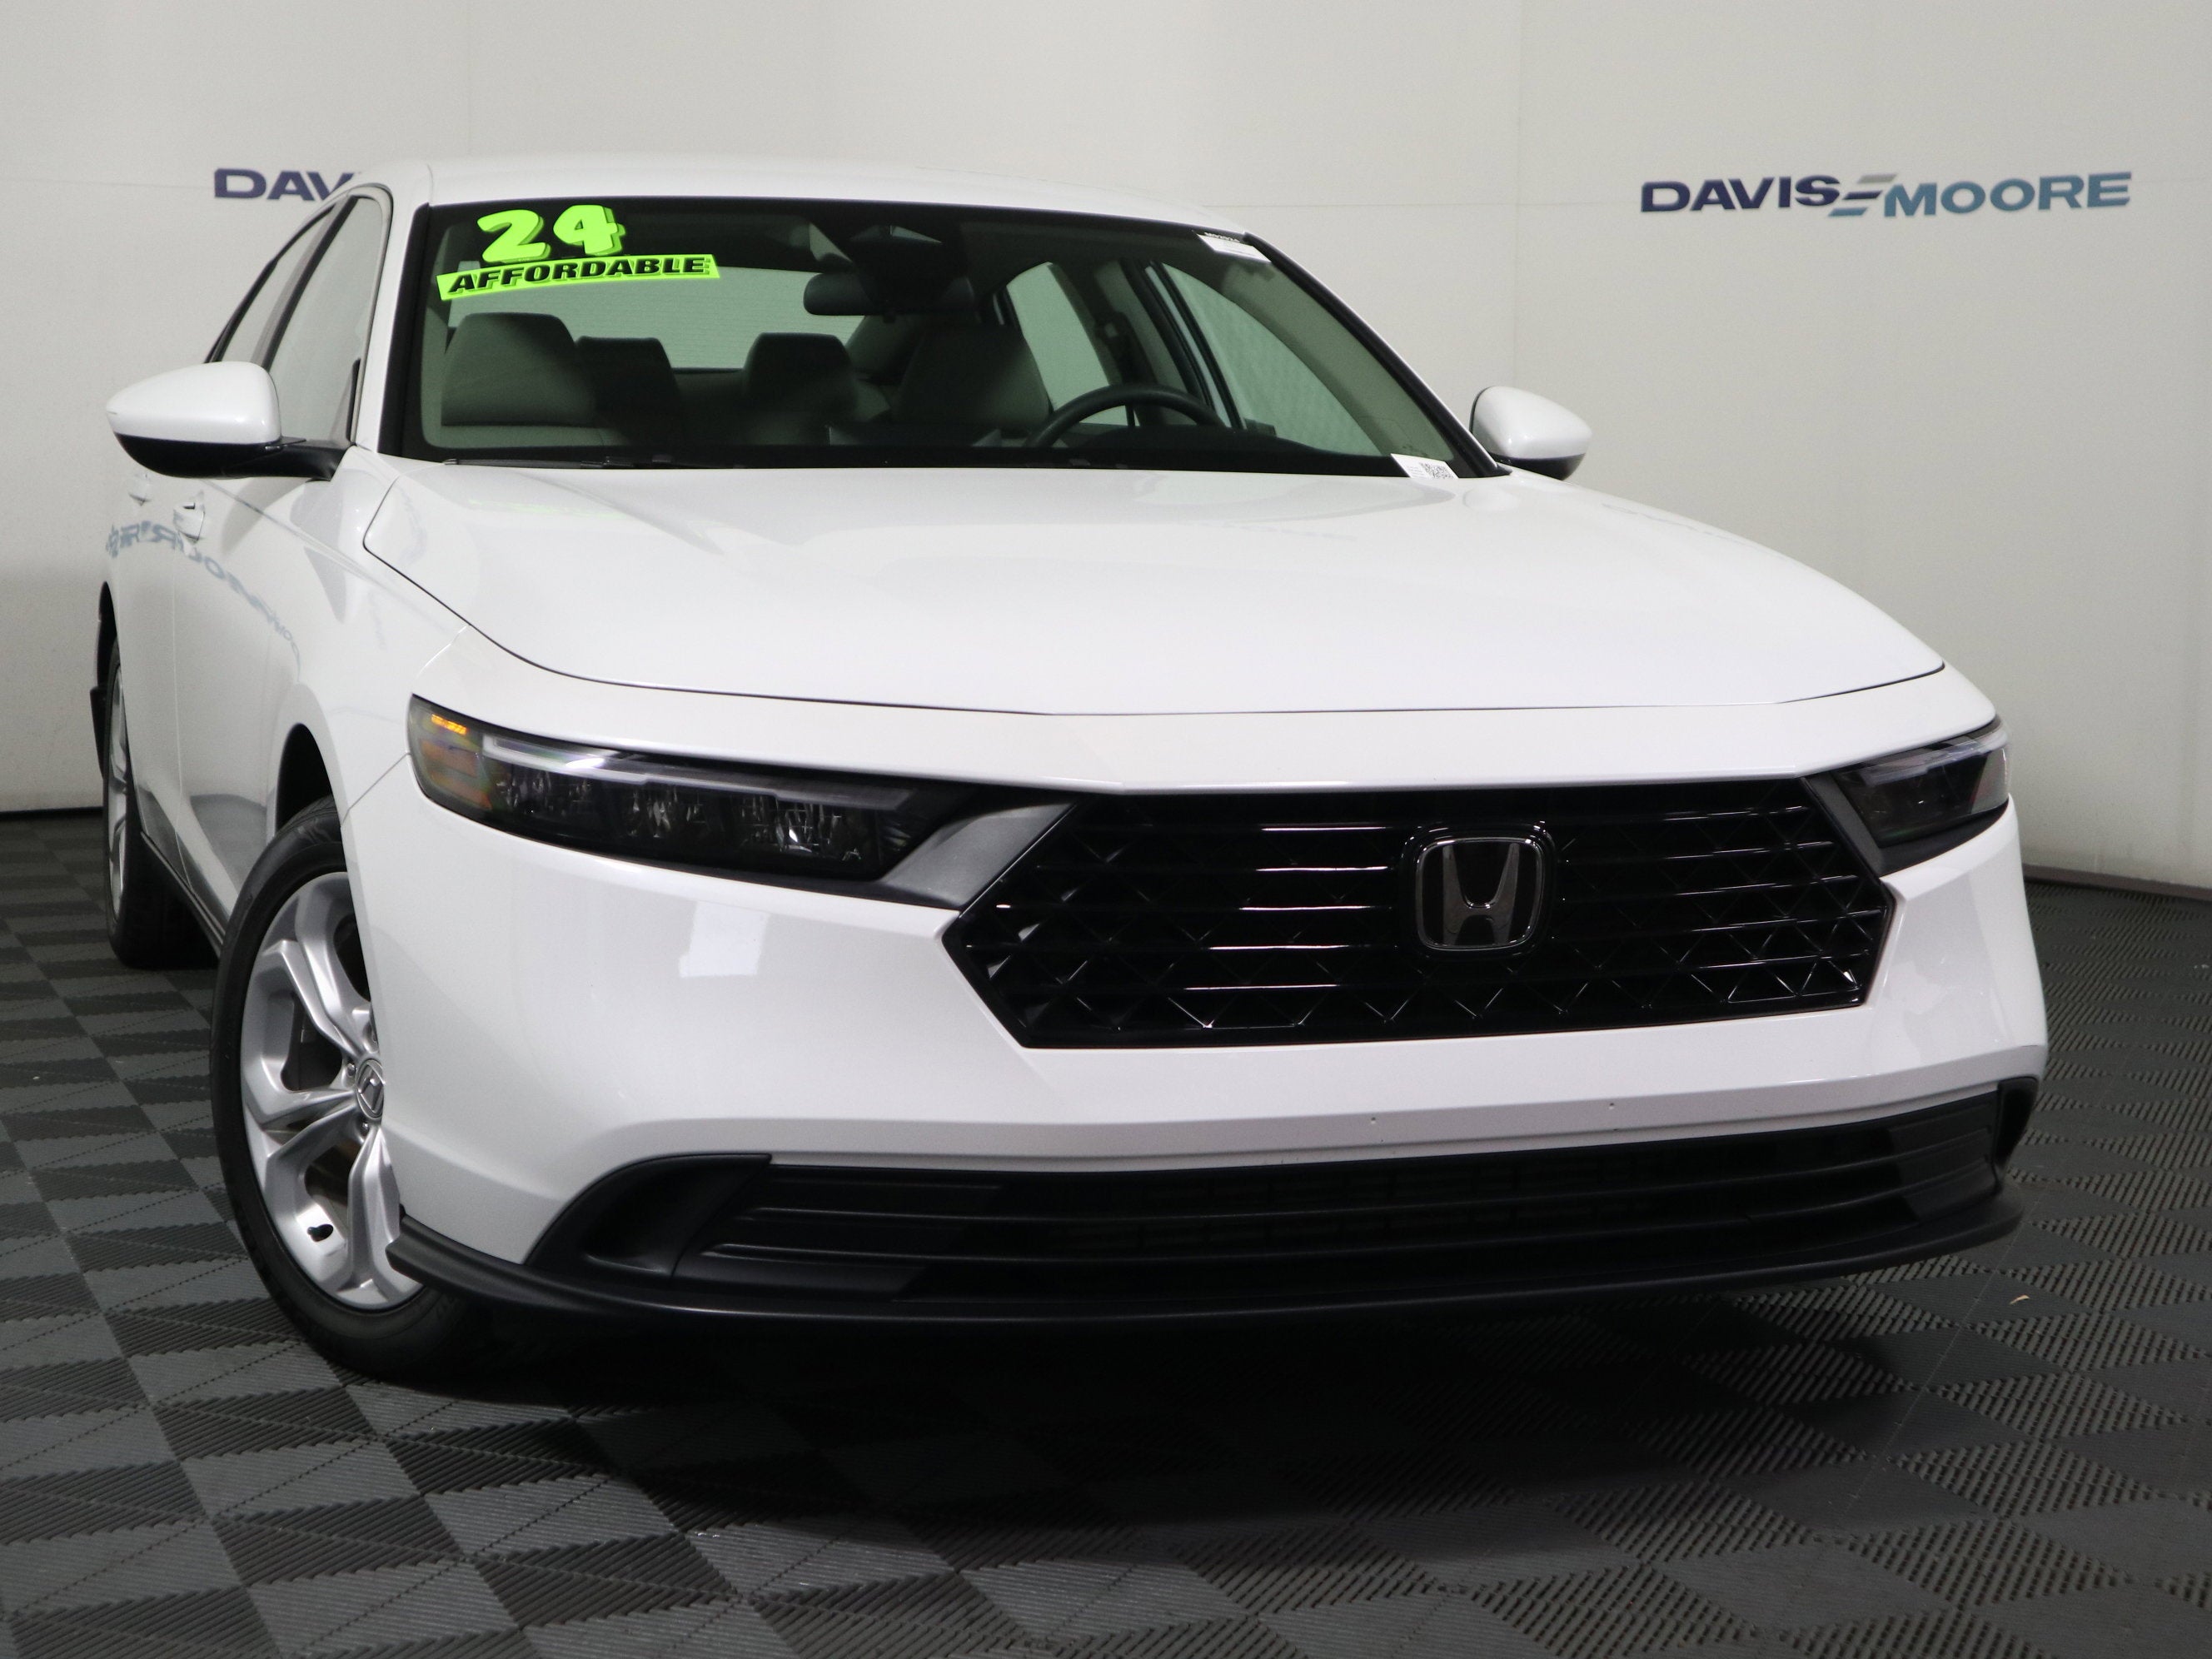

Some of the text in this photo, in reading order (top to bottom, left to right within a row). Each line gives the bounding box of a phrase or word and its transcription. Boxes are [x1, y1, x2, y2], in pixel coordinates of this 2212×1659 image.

[214, 168, 361, 202] DAV
[1641, 171, 2132, 218] DAVIS MOORE
[476, 204, 626, 263] 24
[447, 257, 711, 296] AFFORDABLE
